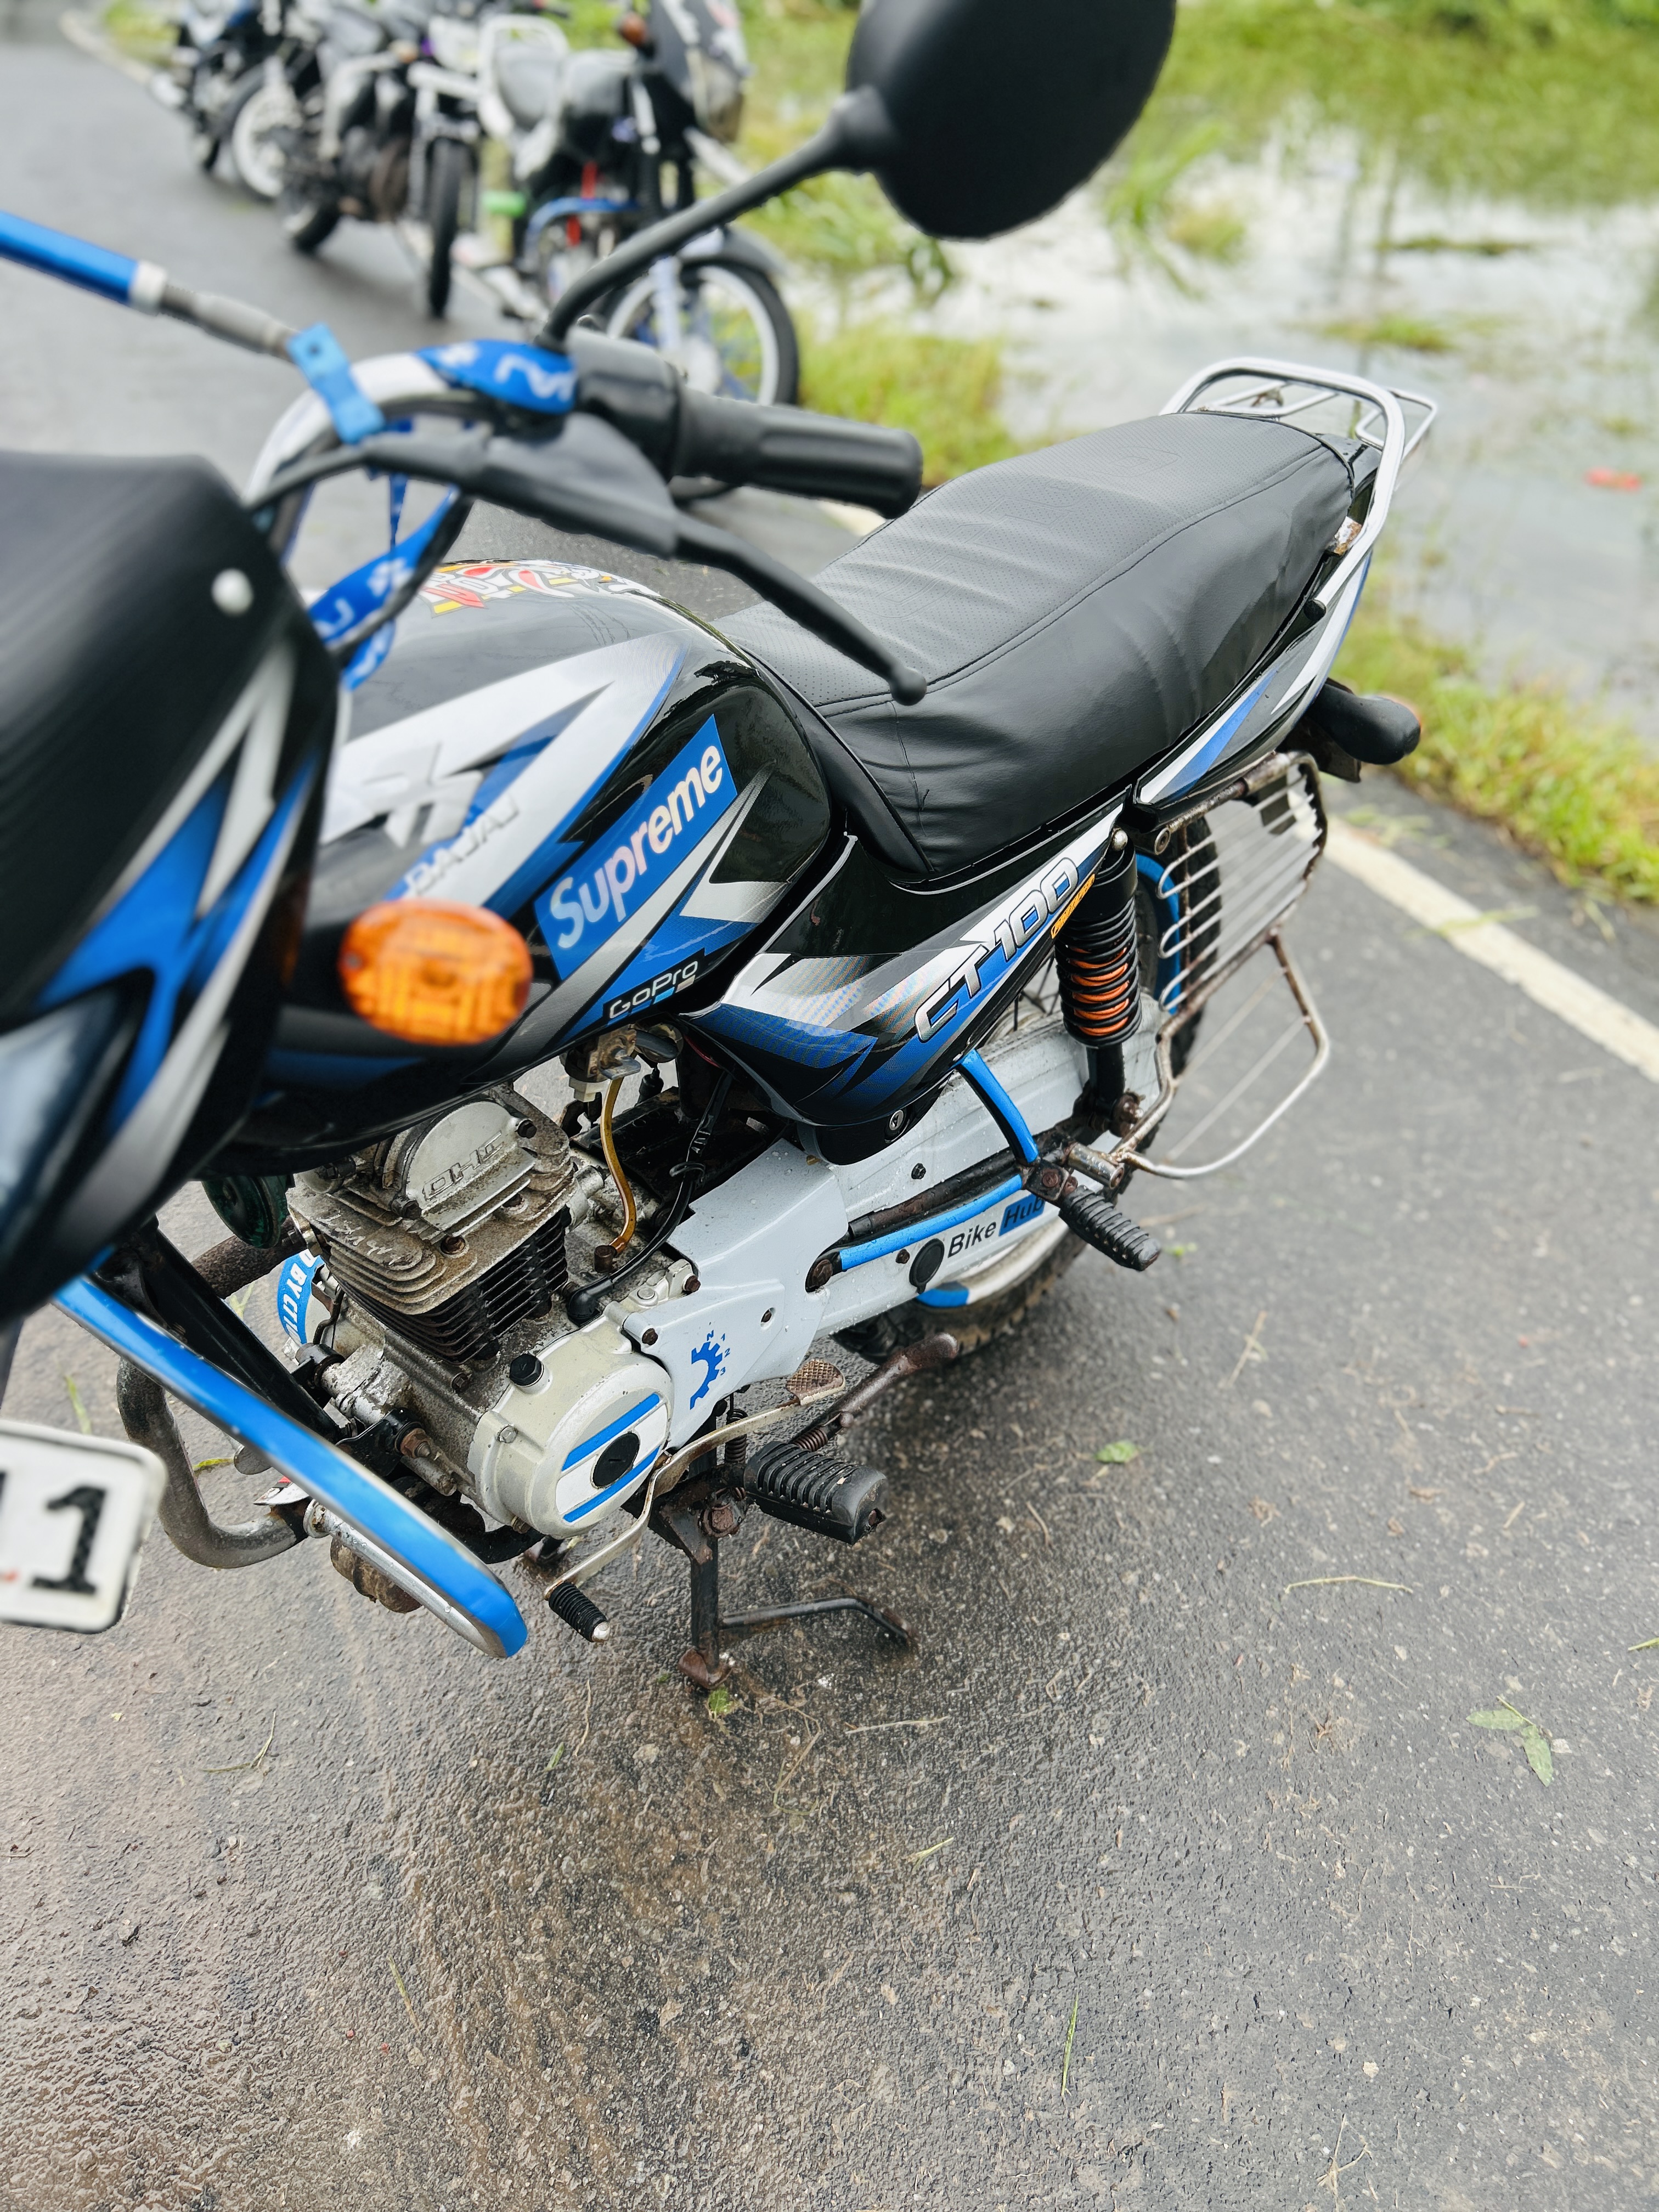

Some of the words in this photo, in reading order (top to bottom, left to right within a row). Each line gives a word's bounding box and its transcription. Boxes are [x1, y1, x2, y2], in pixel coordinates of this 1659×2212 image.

[550, 746, 723, 949] Supreme
[610, 961, 698, 1019] GoPro
[947, 1221, 996, 1259] Bike
[1003, 1196, 1045, 1229] Hub
[286, 1262, 307, 1299] BY
[720, 1367, 726, 1376] 3
[724, 1347, 730, 1358] 2
[0, 1473, 106, 1595] 1
